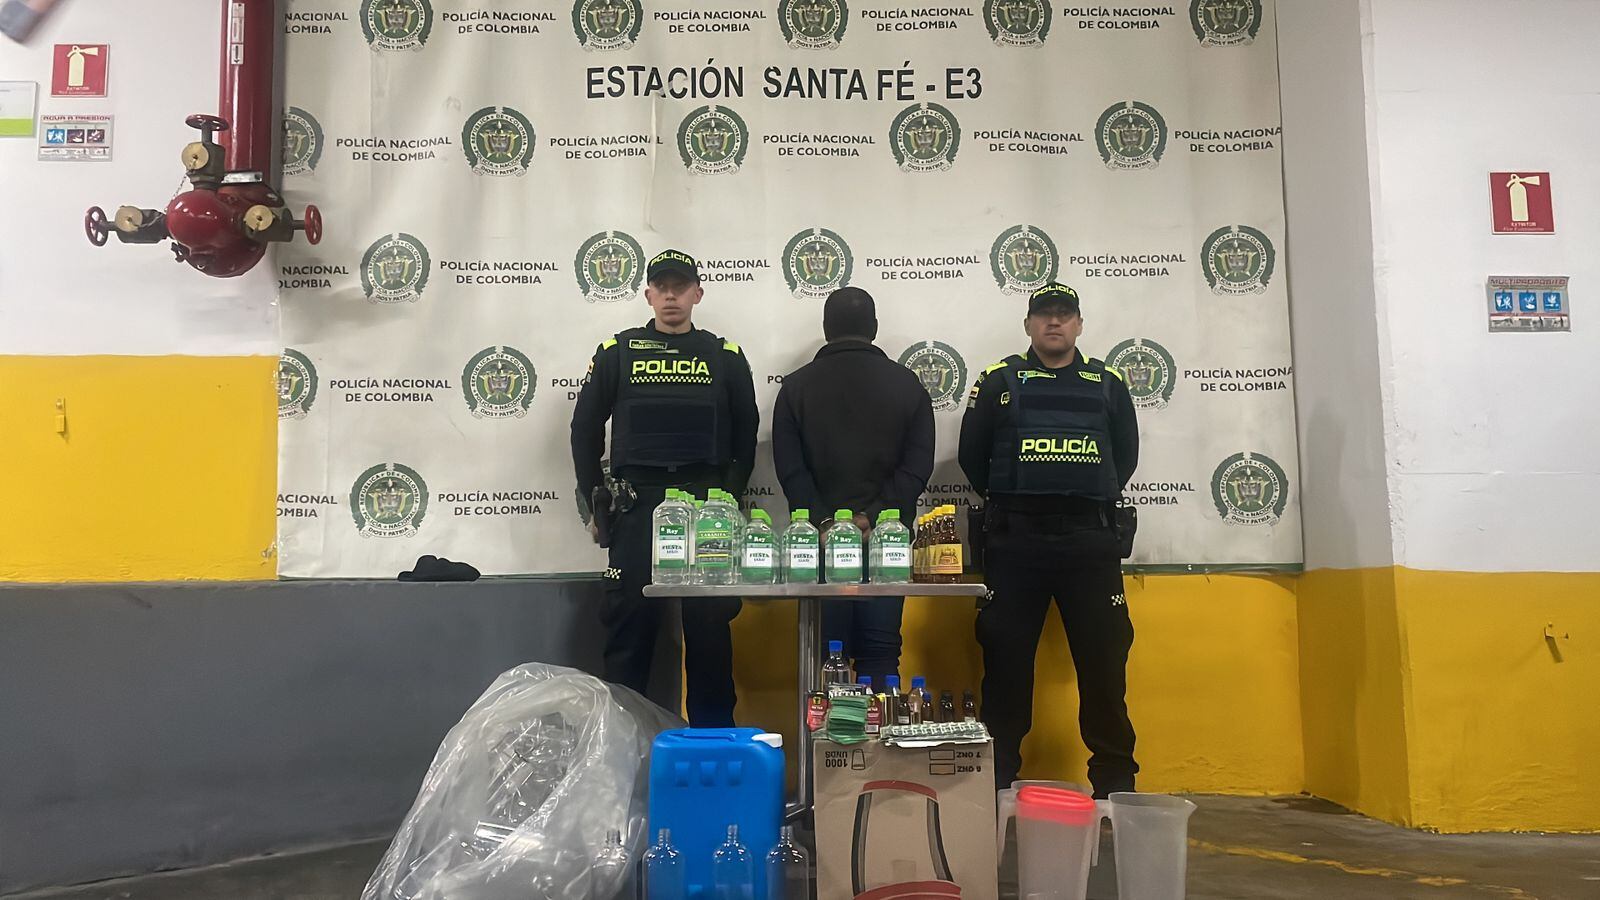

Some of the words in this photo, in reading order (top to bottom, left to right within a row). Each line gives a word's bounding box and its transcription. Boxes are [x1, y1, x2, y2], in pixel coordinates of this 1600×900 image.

[285, 12, 348, 21] NACIONAL
[443, 12, 489, 21] POLICÍA
[493, 12, 556, 21] NACIONAL
[654, 10, 700, 20] POLICÍA
[704, 11, 766, 19] NACIONAL
[862, 8, 908, 18] POLICÍA
[912, 8, 973, 17] NACIONAL
[1064, 7, 1109, 16] POLICÍA
[1113, 7, 1175, 16] NACIONAL
[285, 25, 331, 34] LOMBIA
[459, 25, 472, 33] DE
[476, 24, 539, 33] COLOMBIA
[669, 25, 684, 33] DE
[688, 24, 750, 32] COLOMBIA
[877, 23, 891, 31] DE
[895, 21, 957, 31] COLOMBIA
[1098, 20, 1159, 29] COLOMBIA
[587, 58, 743, 99] ESTACIÓN
[763, 67, 867, 100] SANTA
[878, 61, 914, 100] FÉ
[946, 68, 982, 99] E3
[974, 128, 1021, 139] POLICÍA
[1025, 131, 1083, 141] NACIONAL
[1175, 130, 1220, 139] POLICÍA
[1223, 126, 1282, 139] NACIONA
[337, 137, 386, 148] POLICÍA
[390, 137, 451, 148] NACIONAL
[551, 136, 597, 146] POLICÍA
[764, 133, 809, 143] POLICÍA
[814, 135, 875, 144] NACIONAL
[990, 143, 1004, 151] DE
[1009, 143, 1067, 154] COLOMBIA
[1190, 144, 1204, 152] DE
[1208, 141, 1273, 152] COLOMBIA
[353, 152, 368, 160] DE
[372, 151, 435, 161] COLOMBIA
[566, 151, 580, 159] DE
[585, 148, 646, 158] COLOMBIA
[797, 148, 859, 156] COLOMBIA
[708, 260, 770, 268] NACIONAL
[867, 257, 913, 266] POLICÍA
[917, 256, 980, 266] NACIONAL
[1070, 254, 1117, 264] POLICÍA
[1121, 254, 1185, 263] NACIONAL
[282, 264, 348, 275] NACIONAL
[441, 261, 490, 271] POLICÍA
[699, 272, 754, 283] OLOMBIA
[901, 270, 963, 279] COLOMBIA
[1086, 269, 1101, 277] DE
[1105, 268, 1169, 276] COLOMBIA
[279, 279, 331, 289] LOMBIA
[457, 275, 472, 283] DE
[477, 276, 541, 284] COLOMBIA
[632, 357, 710, 376] POLICÍA
[1185, 368, 1232, 378] POLICÍA
[1235, 366, 1294, 378] NACIONA
[331, 378, 379, 388] POLICÍA
[383, 379, 451, 388] NACIONAL
[552, 379, 586, 388] POLIC
[1201, 383, 1216, 391] DE
[1220, 381, 1286, 391] COLOMBIA
[346, 393, 361, 402] DE
[365, 393, 433, 401] COLOMBIA
[1021, 435, 1099, 455] POLICÍA
[743, 487, 775, 496] ONAL
[924, 484, 970, 494] NACION
[1131, 483, 1194, 491] NACIONAL
[277, 495, 338, 505] ACIONAL
[439, 491, 489, 502] POLICÍA
[493, 491, 559, 501] NACIONAL
[1122, 496, 1179, 505] OLOMBIA
[916, 498, 970, 507] OLOMBIA
[276, 508, 318, 518] OMBIA
[455, 507, 470, 515] DE
[475, 505, 541, 515] COLOMBIA
[825, 759, 848, 768] 1000
